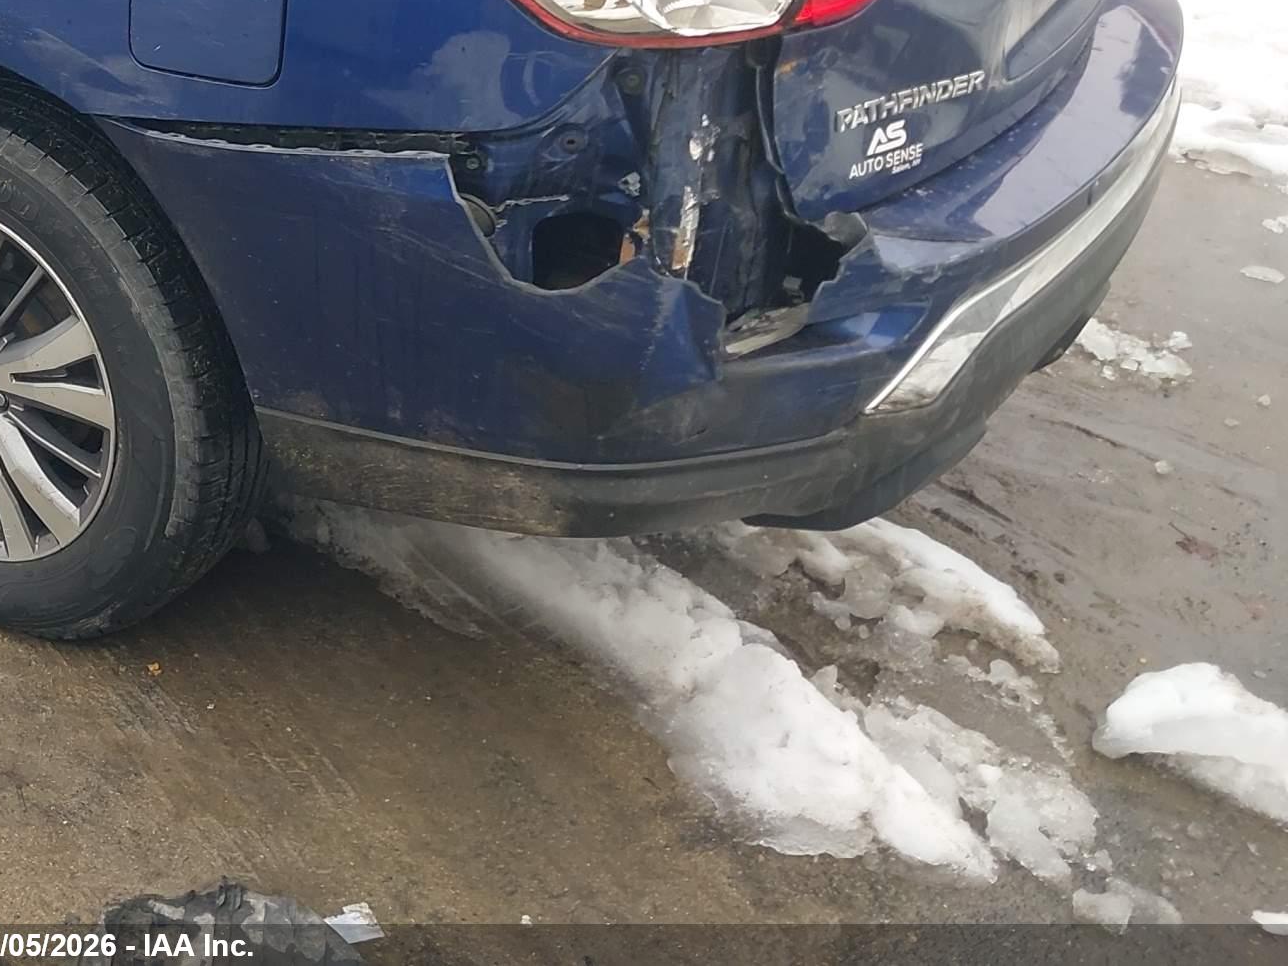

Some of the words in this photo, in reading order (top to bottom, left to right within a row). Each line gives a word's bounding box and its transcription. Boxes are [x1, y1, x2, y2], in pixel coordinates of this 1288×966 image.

[836, 70, 986, 132] PATHFINDER
[866, 119, 908, 157] AS
[848, 156, 884, 180] AUTO
[885, 142, 924, 168] SENSE
